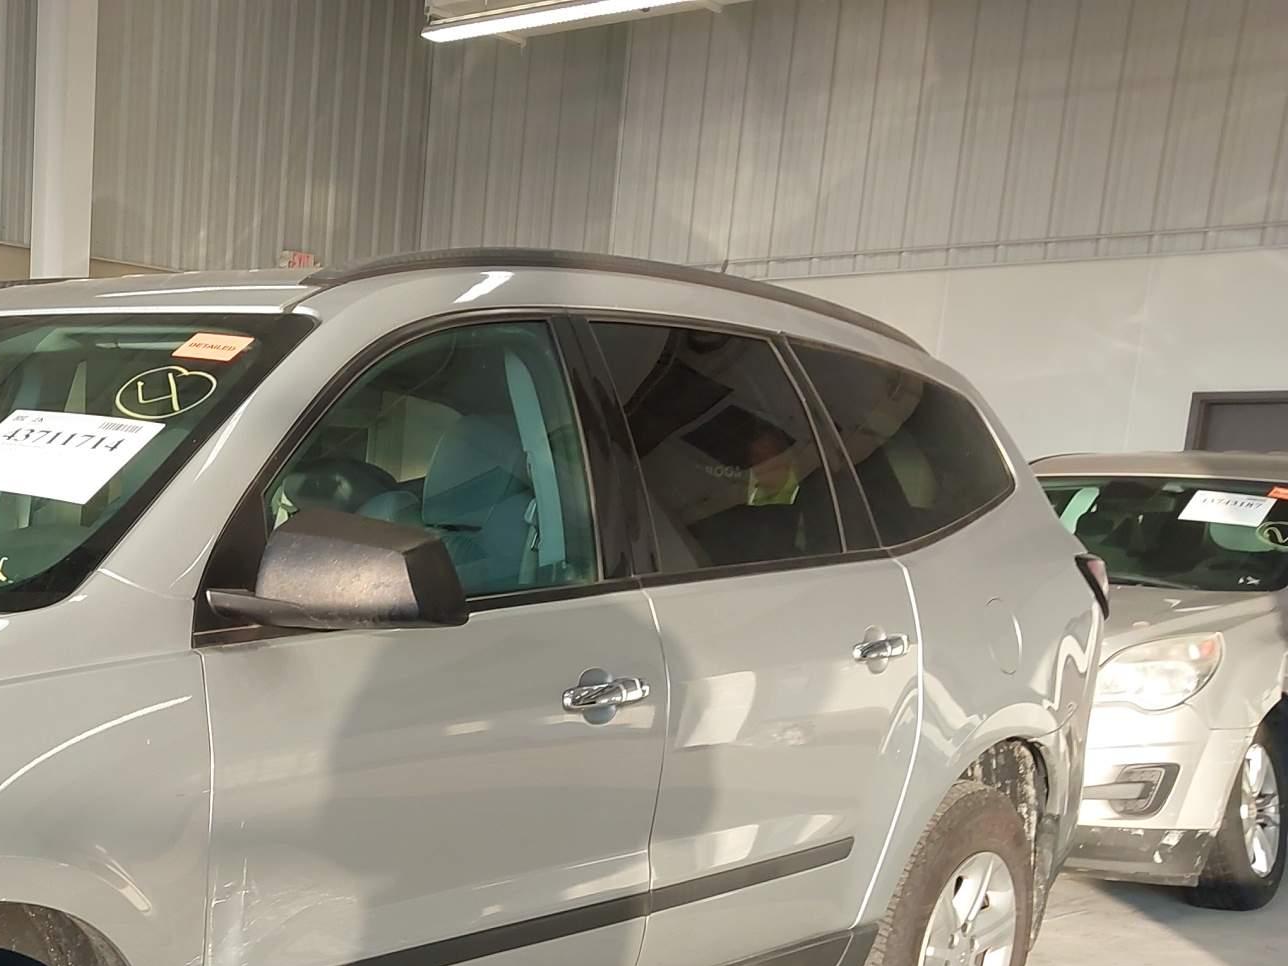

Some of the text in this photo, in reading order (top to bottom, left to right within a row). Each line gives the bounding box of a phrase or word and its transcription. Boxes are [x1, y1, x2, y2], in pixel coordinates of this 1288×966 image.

[188, 341, 237, 353] DETAILED
[136, 372, 180, 412] 4
[3, 428, 124, 452] 43711714
